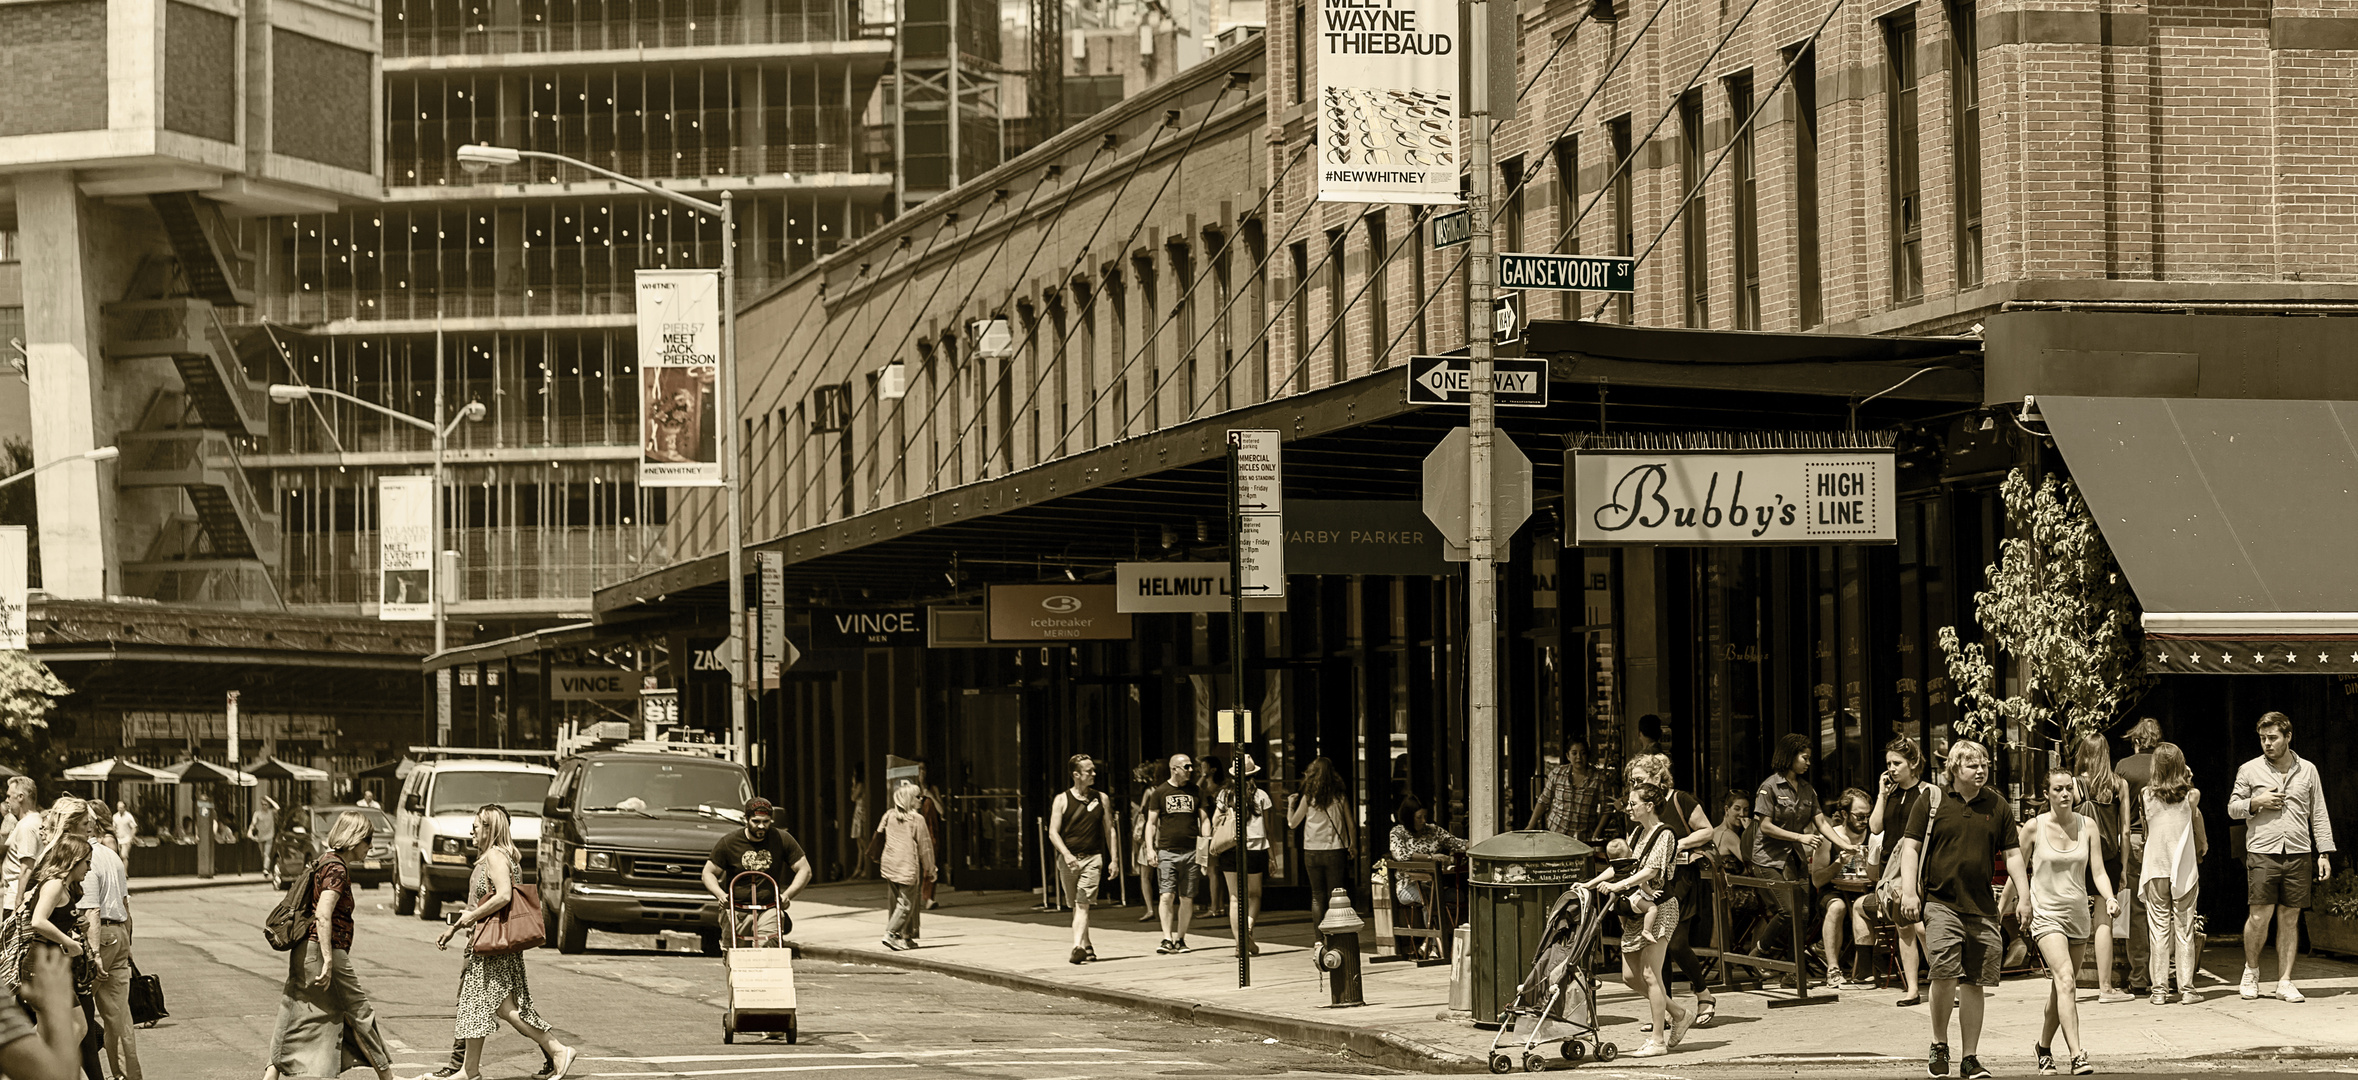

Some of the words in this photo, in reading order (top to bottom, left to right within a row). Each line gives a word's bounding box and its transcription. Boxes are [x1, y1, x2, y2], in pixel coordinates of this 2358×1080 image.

[1325, 10, 1416, 31] WAYNE
[1325, 33, 1452, 55] THIEBAUD
[1325, 171, 1426, 183] #NEWWHITNEY
[1502, 258, 1611, 288] GANSEVOORT
[1617, 263, 1630, 277] ST
[662, 323, 689, 333] PIER
[691, 323, 705, 333] 57
[662, 333, 695, 343] MEET
[663, 344, 694, 354] JACK
[663, 354, 716, 365] PIERSON
[1431, 372, 1469, 389] ONE
[1238, 454, 1270, 462] MMERCIAL
[1238, 463, 1260, 471] HICLES
[1260, 463, 1276, 471] ONLY
[1817, 472, 1864, 496] HIGH
[1594, 463, 1797, 537] Bubby's
[1818, 500, 1865, 524] LINE
[1284, 530, 1341, 544] ARBY
[1351, 531, 1424, 544] PARKER
[1139, 577, 1214, 596] HELMUT
[835, 613, 920, 633] VINCE.
[1030, 617, 1092, 627] icebreaker
[868, 635, 887, 643] MEN
[1043, 630, 1080, 638] MERINO
[561, 677, 624, 693] VINCE.
